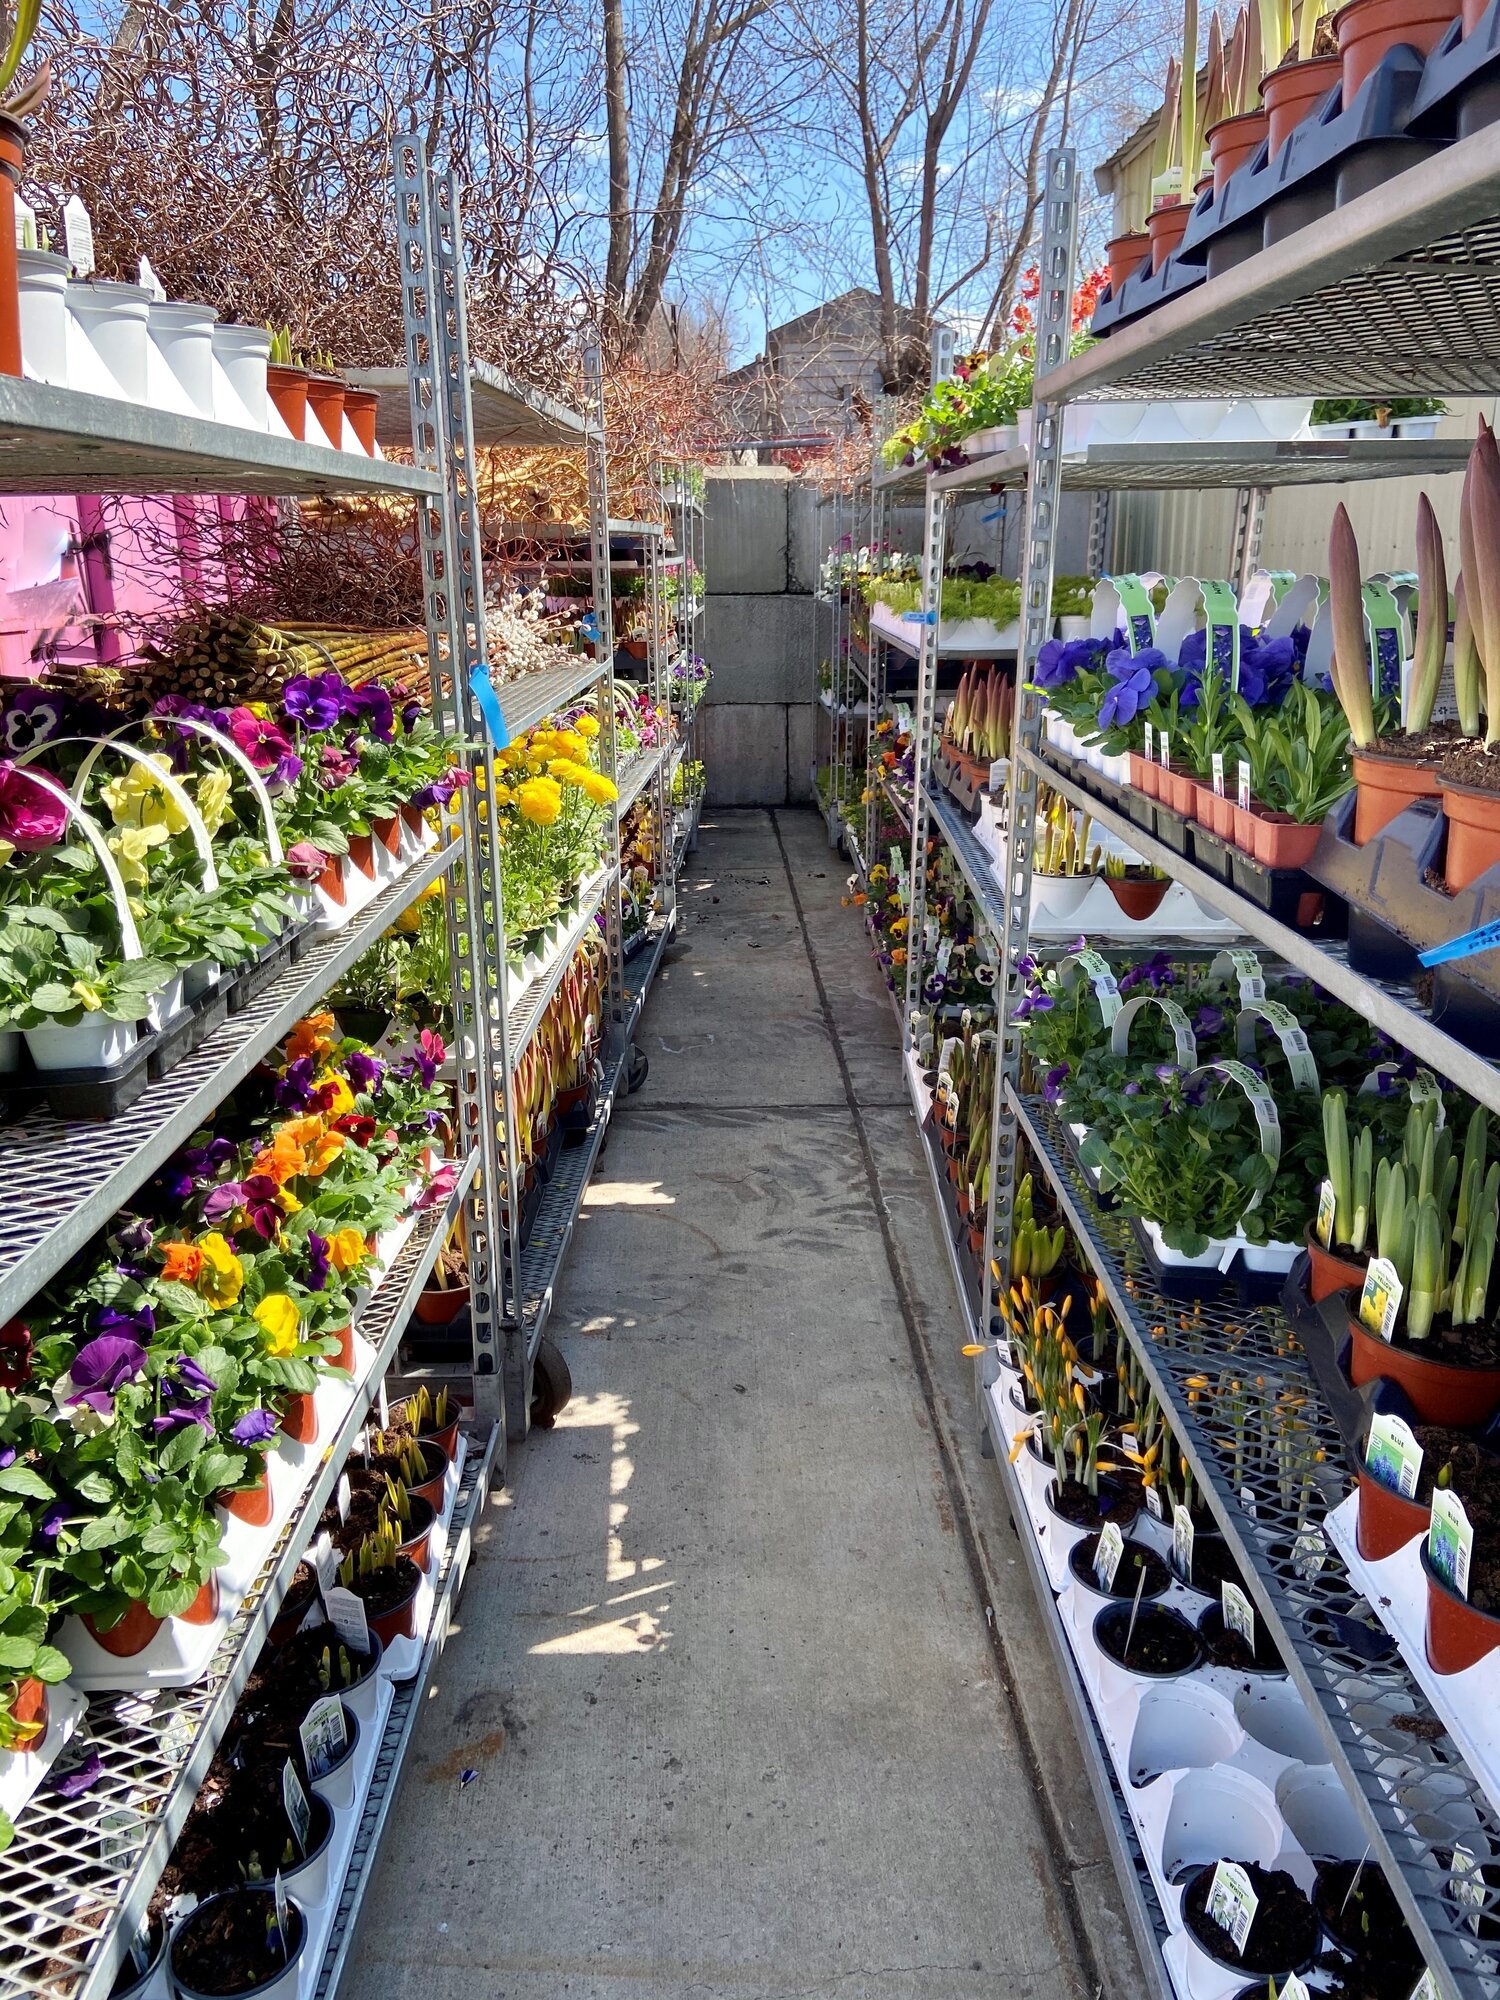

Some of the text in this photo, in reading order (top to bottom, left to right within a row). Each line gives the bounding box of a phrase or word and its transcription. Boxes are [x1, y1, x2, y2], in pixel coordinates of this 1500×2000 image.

[1087, 956, 1102, 973] DELTA
[1273, 1008, 1289, 1027] DELTA
[1240, 1071, 1260, 1093] DELTA
[1390, 1433, 1405, 1449] BLUE
[1447, 1510, 1460, 1527] BLUE
[1229, 1881, 1244, 1900] WHITE
